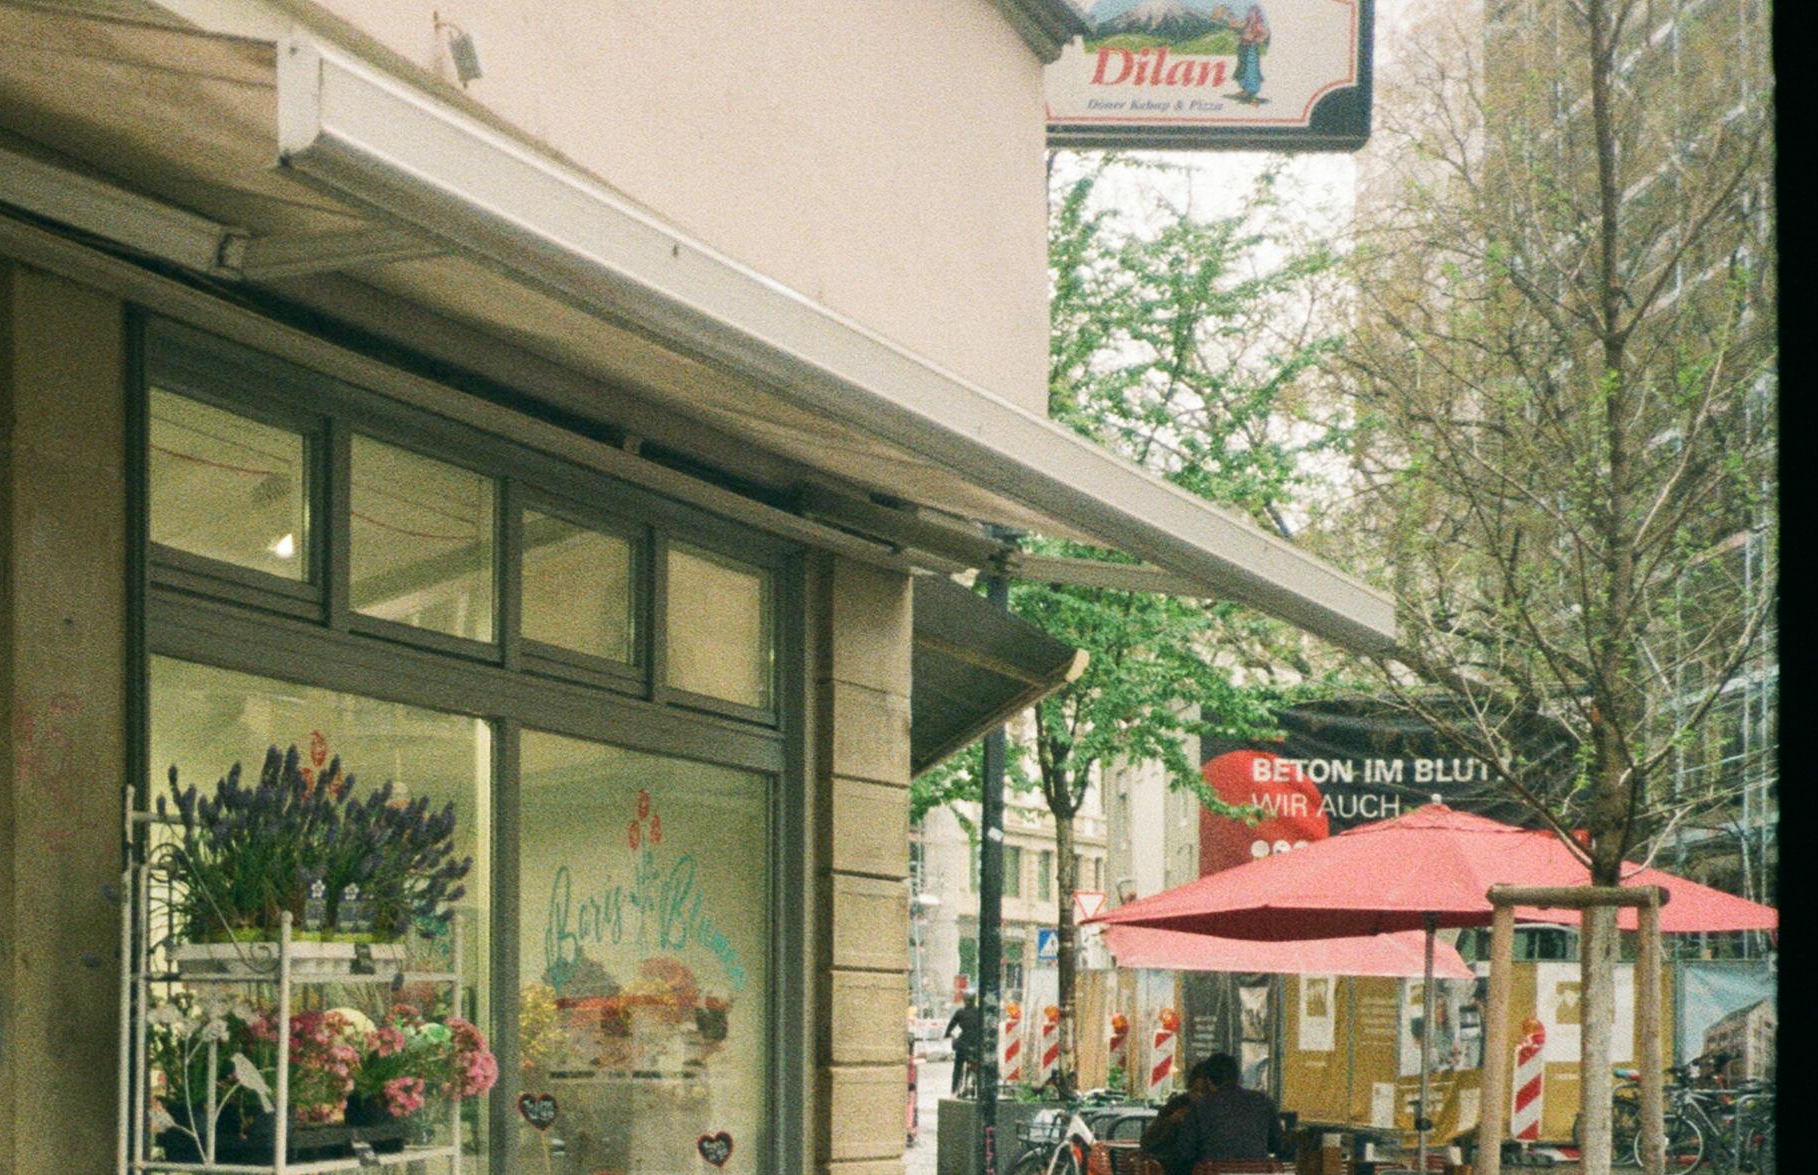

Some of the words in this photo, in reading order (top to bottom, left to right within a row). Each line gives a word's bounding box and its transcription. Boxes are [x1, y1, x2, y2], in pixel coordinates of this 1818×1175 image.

[1089, 46, 1227, 87] Dilan
[1174, 101, 1183, 111] &
[1189, 100, 1223, 111] Pizza
[1252, 758, 1353, 783] BETON
[1364, 758, 1403, 783] IM
[1251, 794, 1308, 818] WIR
[1317, 794, 1400, 818] AUCH
